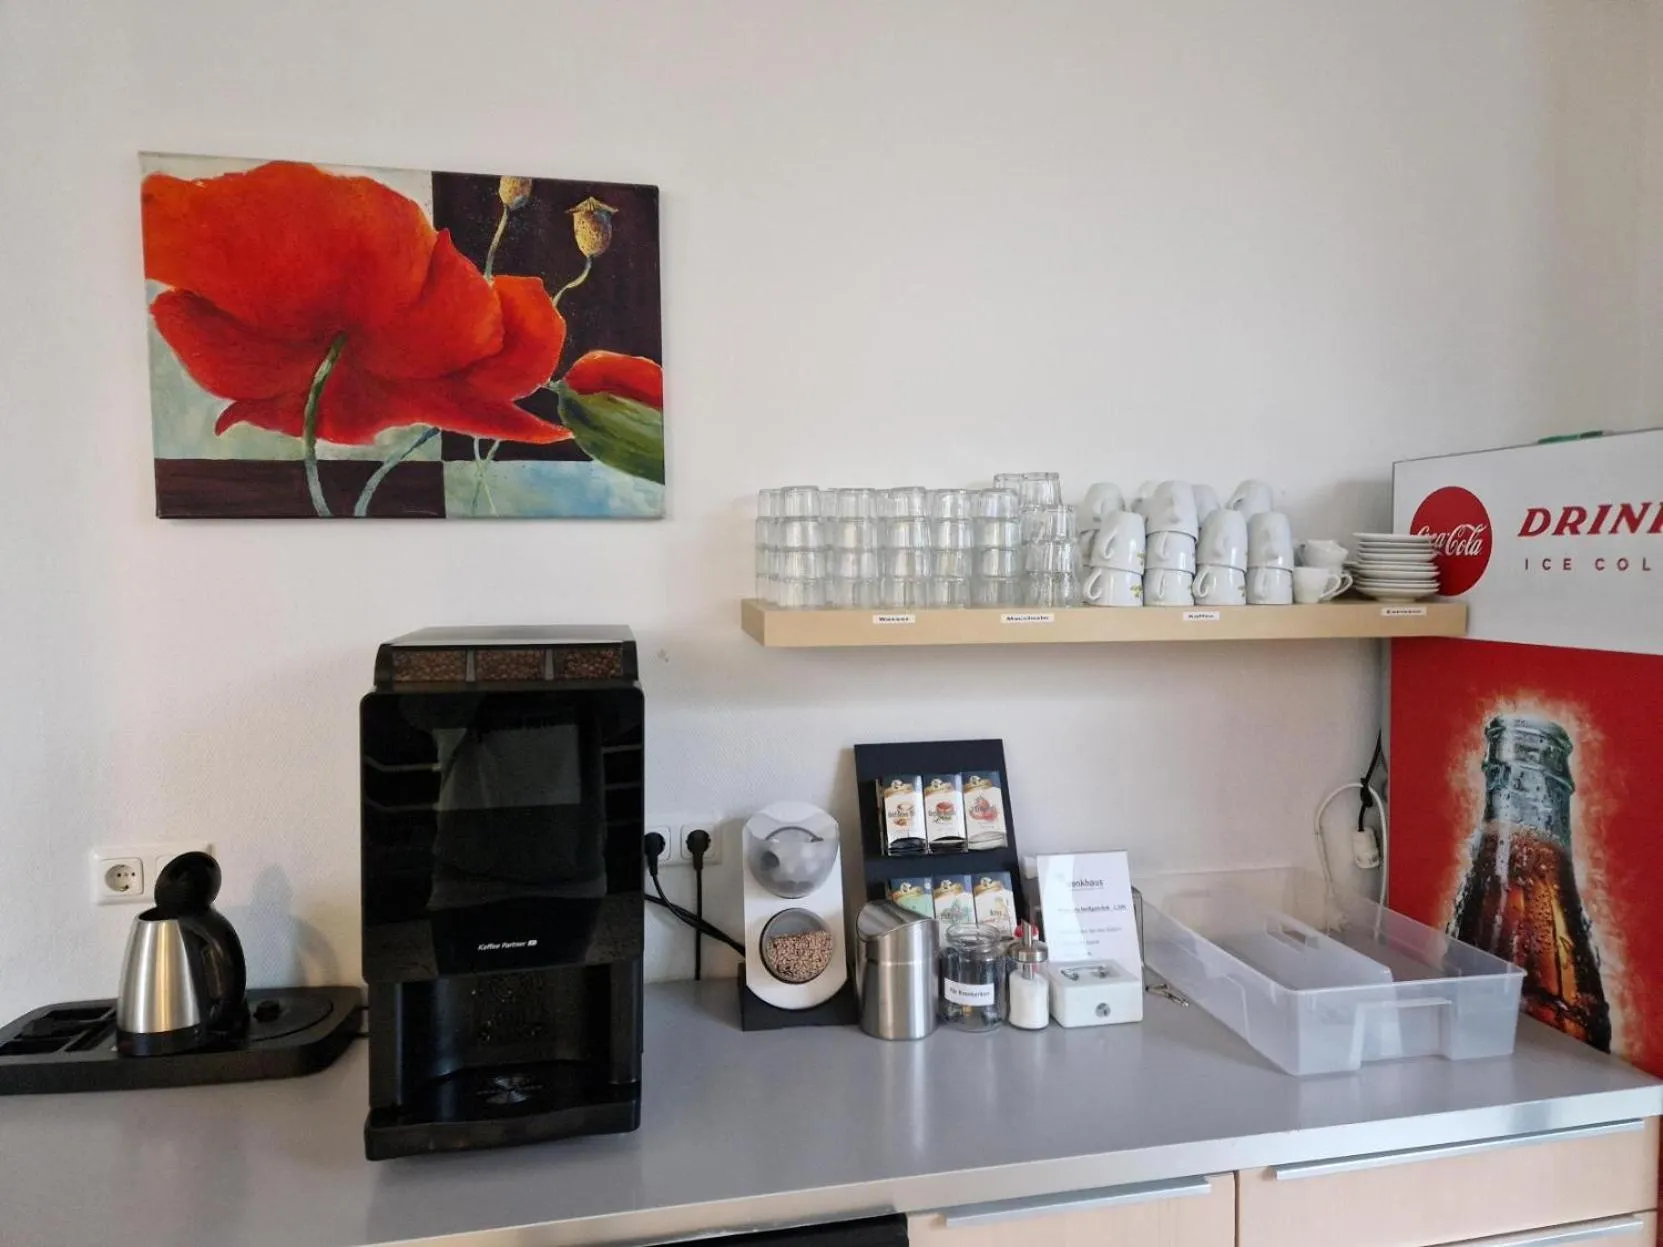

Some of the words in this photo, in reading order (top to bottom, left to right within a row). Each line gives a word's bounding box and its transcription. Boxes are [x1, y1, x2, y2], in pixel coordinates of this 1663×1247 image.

[1524, 557, 1572, 572] ICE
[1594, 556, 1652, 572] COL
[477, 943, 501, 951] Kaffee
[502, 941, 526, 949] Partner
